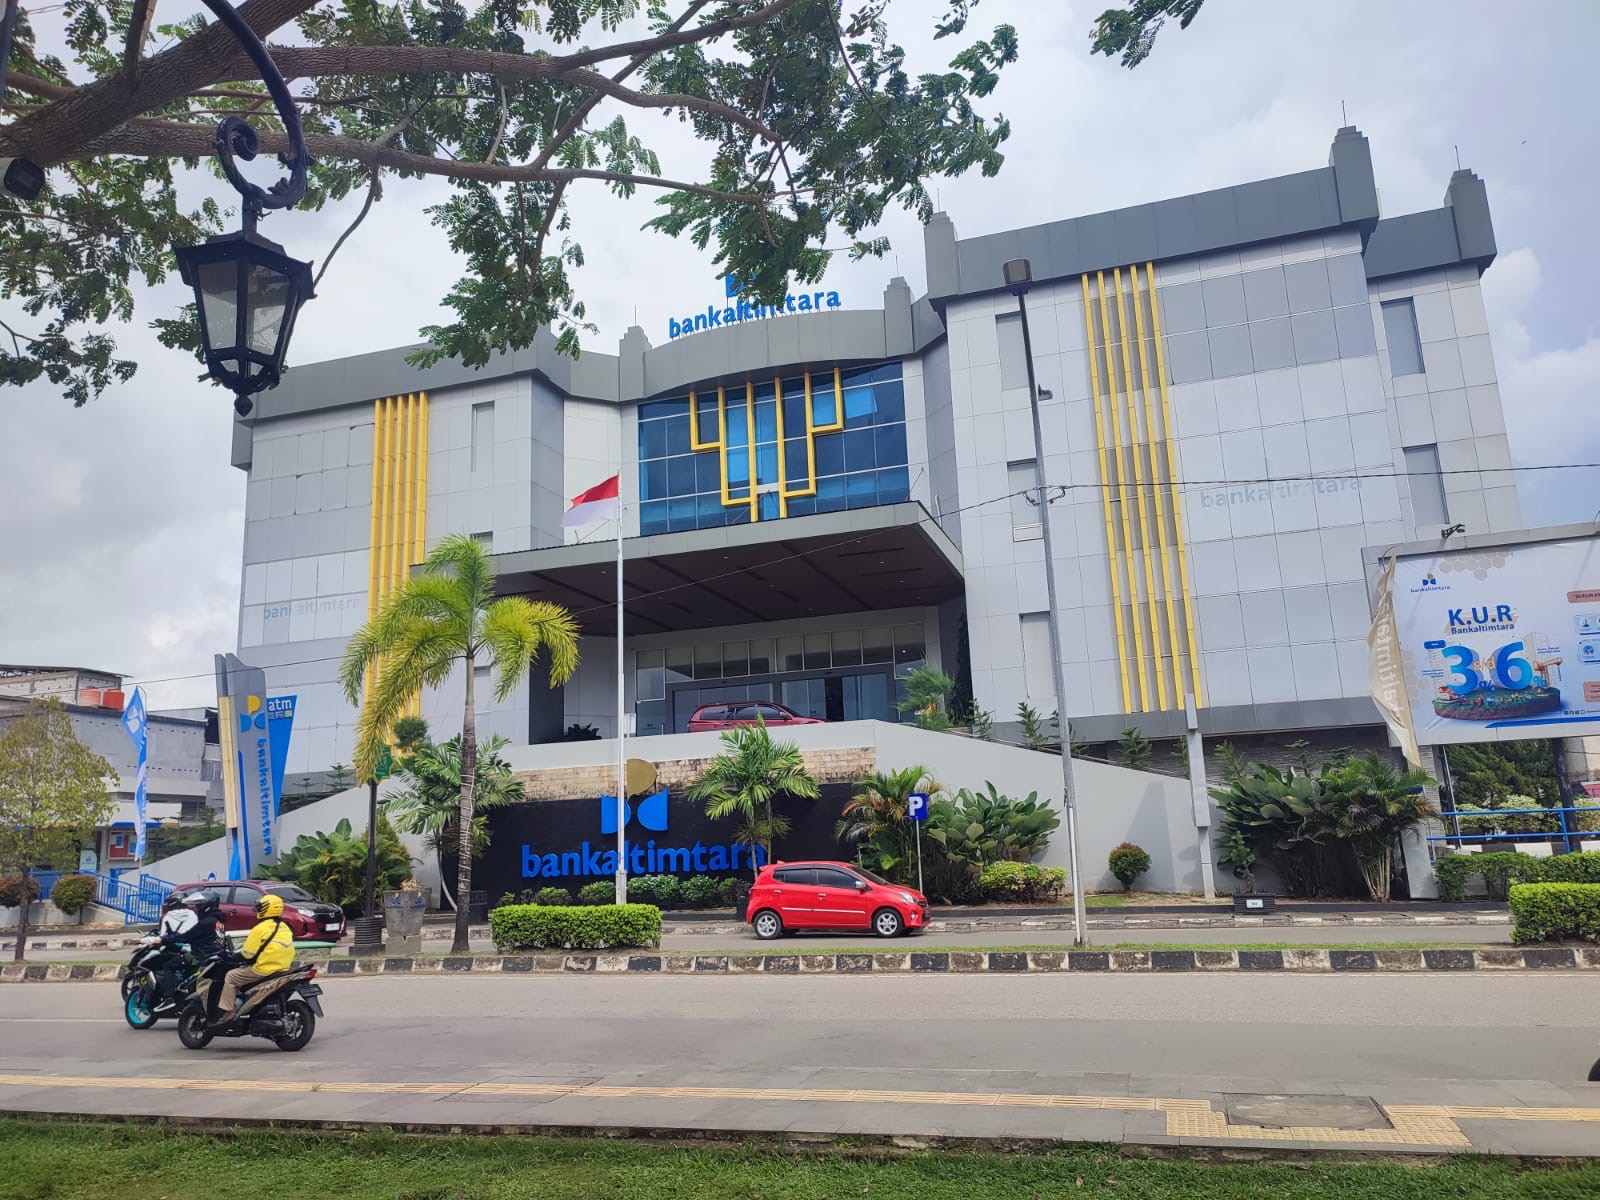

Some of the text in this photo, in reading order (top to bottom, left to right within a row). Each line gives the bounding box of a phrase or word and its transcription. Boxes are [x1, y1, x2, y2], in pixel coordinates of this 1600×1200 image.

[1448, 605, 1513, 626] K.U.R
[1451, 623, 1515, 634] Bankaltimtara
[268, 698, 292, 711] atm
[257, 738, 273, 856] bankaltimtara
[908, 796, 924, 816] P
[521, 840, 767, 879] bankaltimtara
